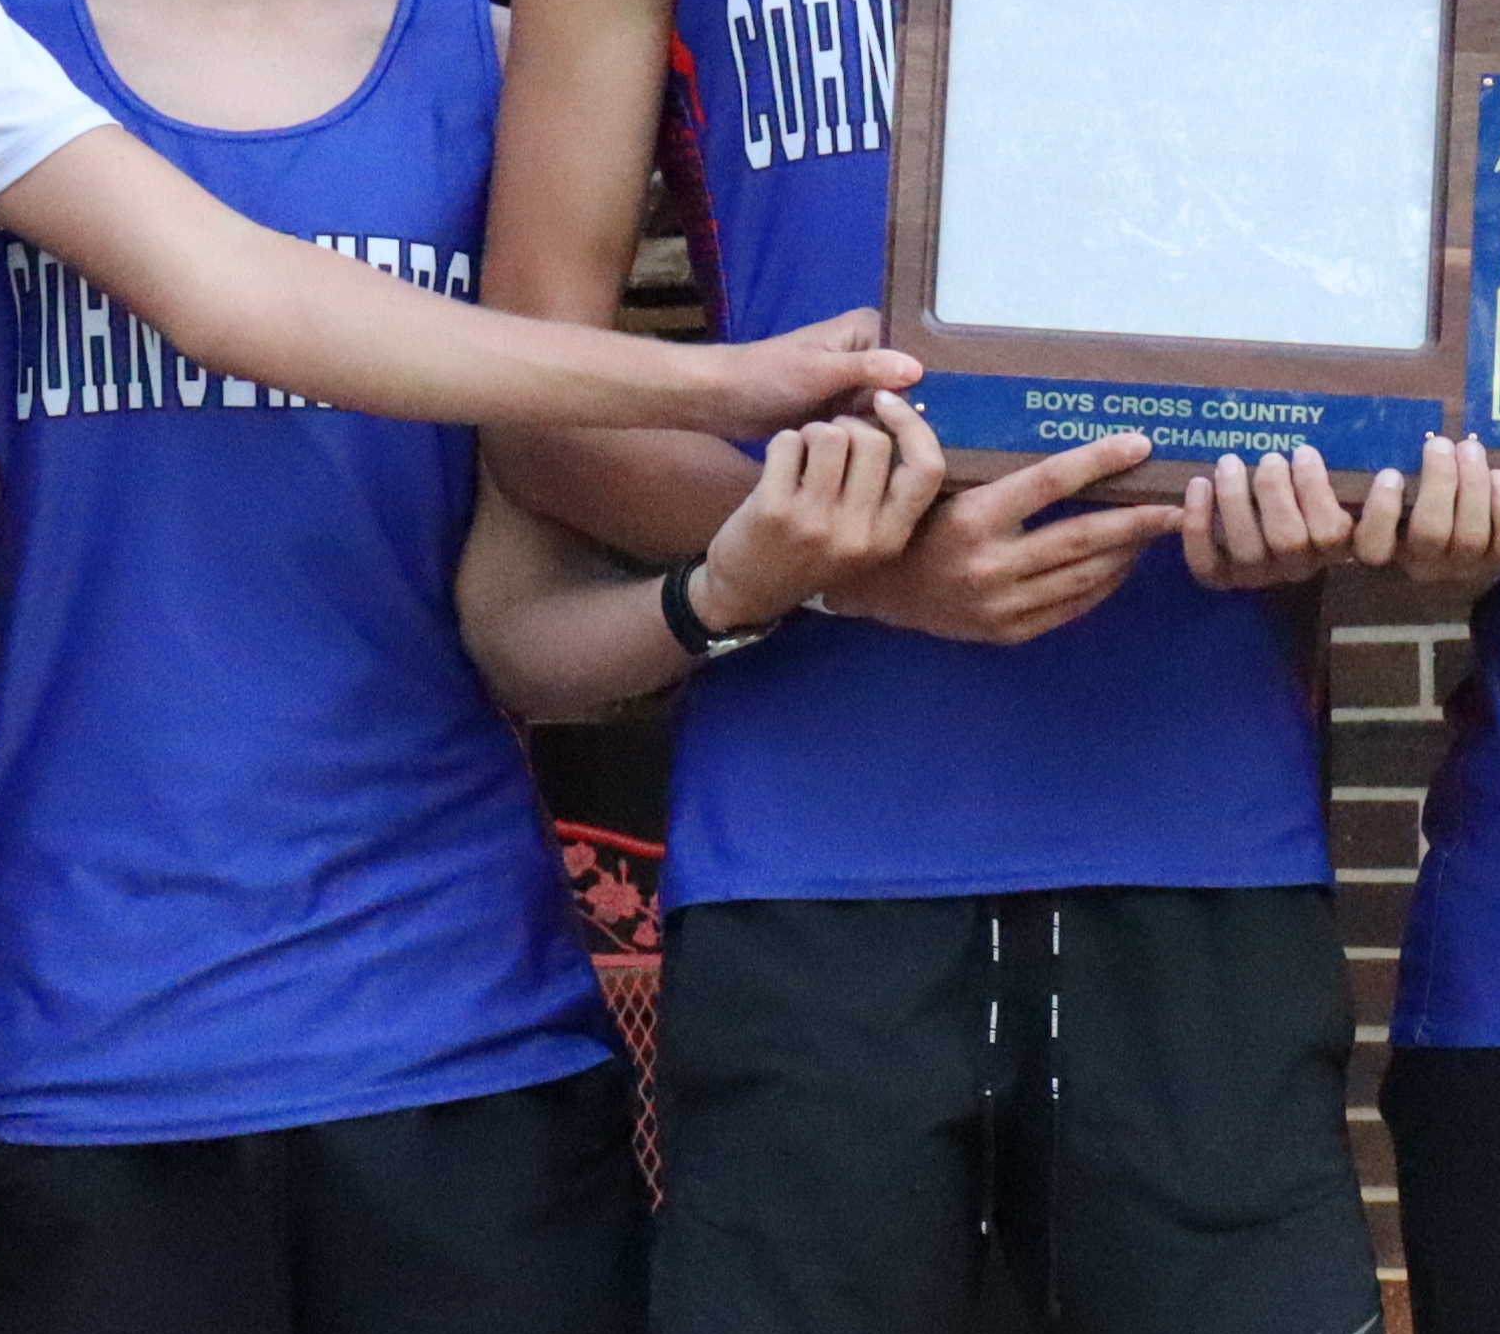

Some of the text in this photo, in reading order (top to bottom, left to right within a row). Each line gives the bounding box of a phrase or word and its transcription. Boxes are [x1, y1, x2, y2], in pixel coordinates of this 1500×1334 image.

[1025, 390, 1325, 425] BOYS CROSS COUNTRY
[1152, 426, 1307, 452] CHAMPIONS
